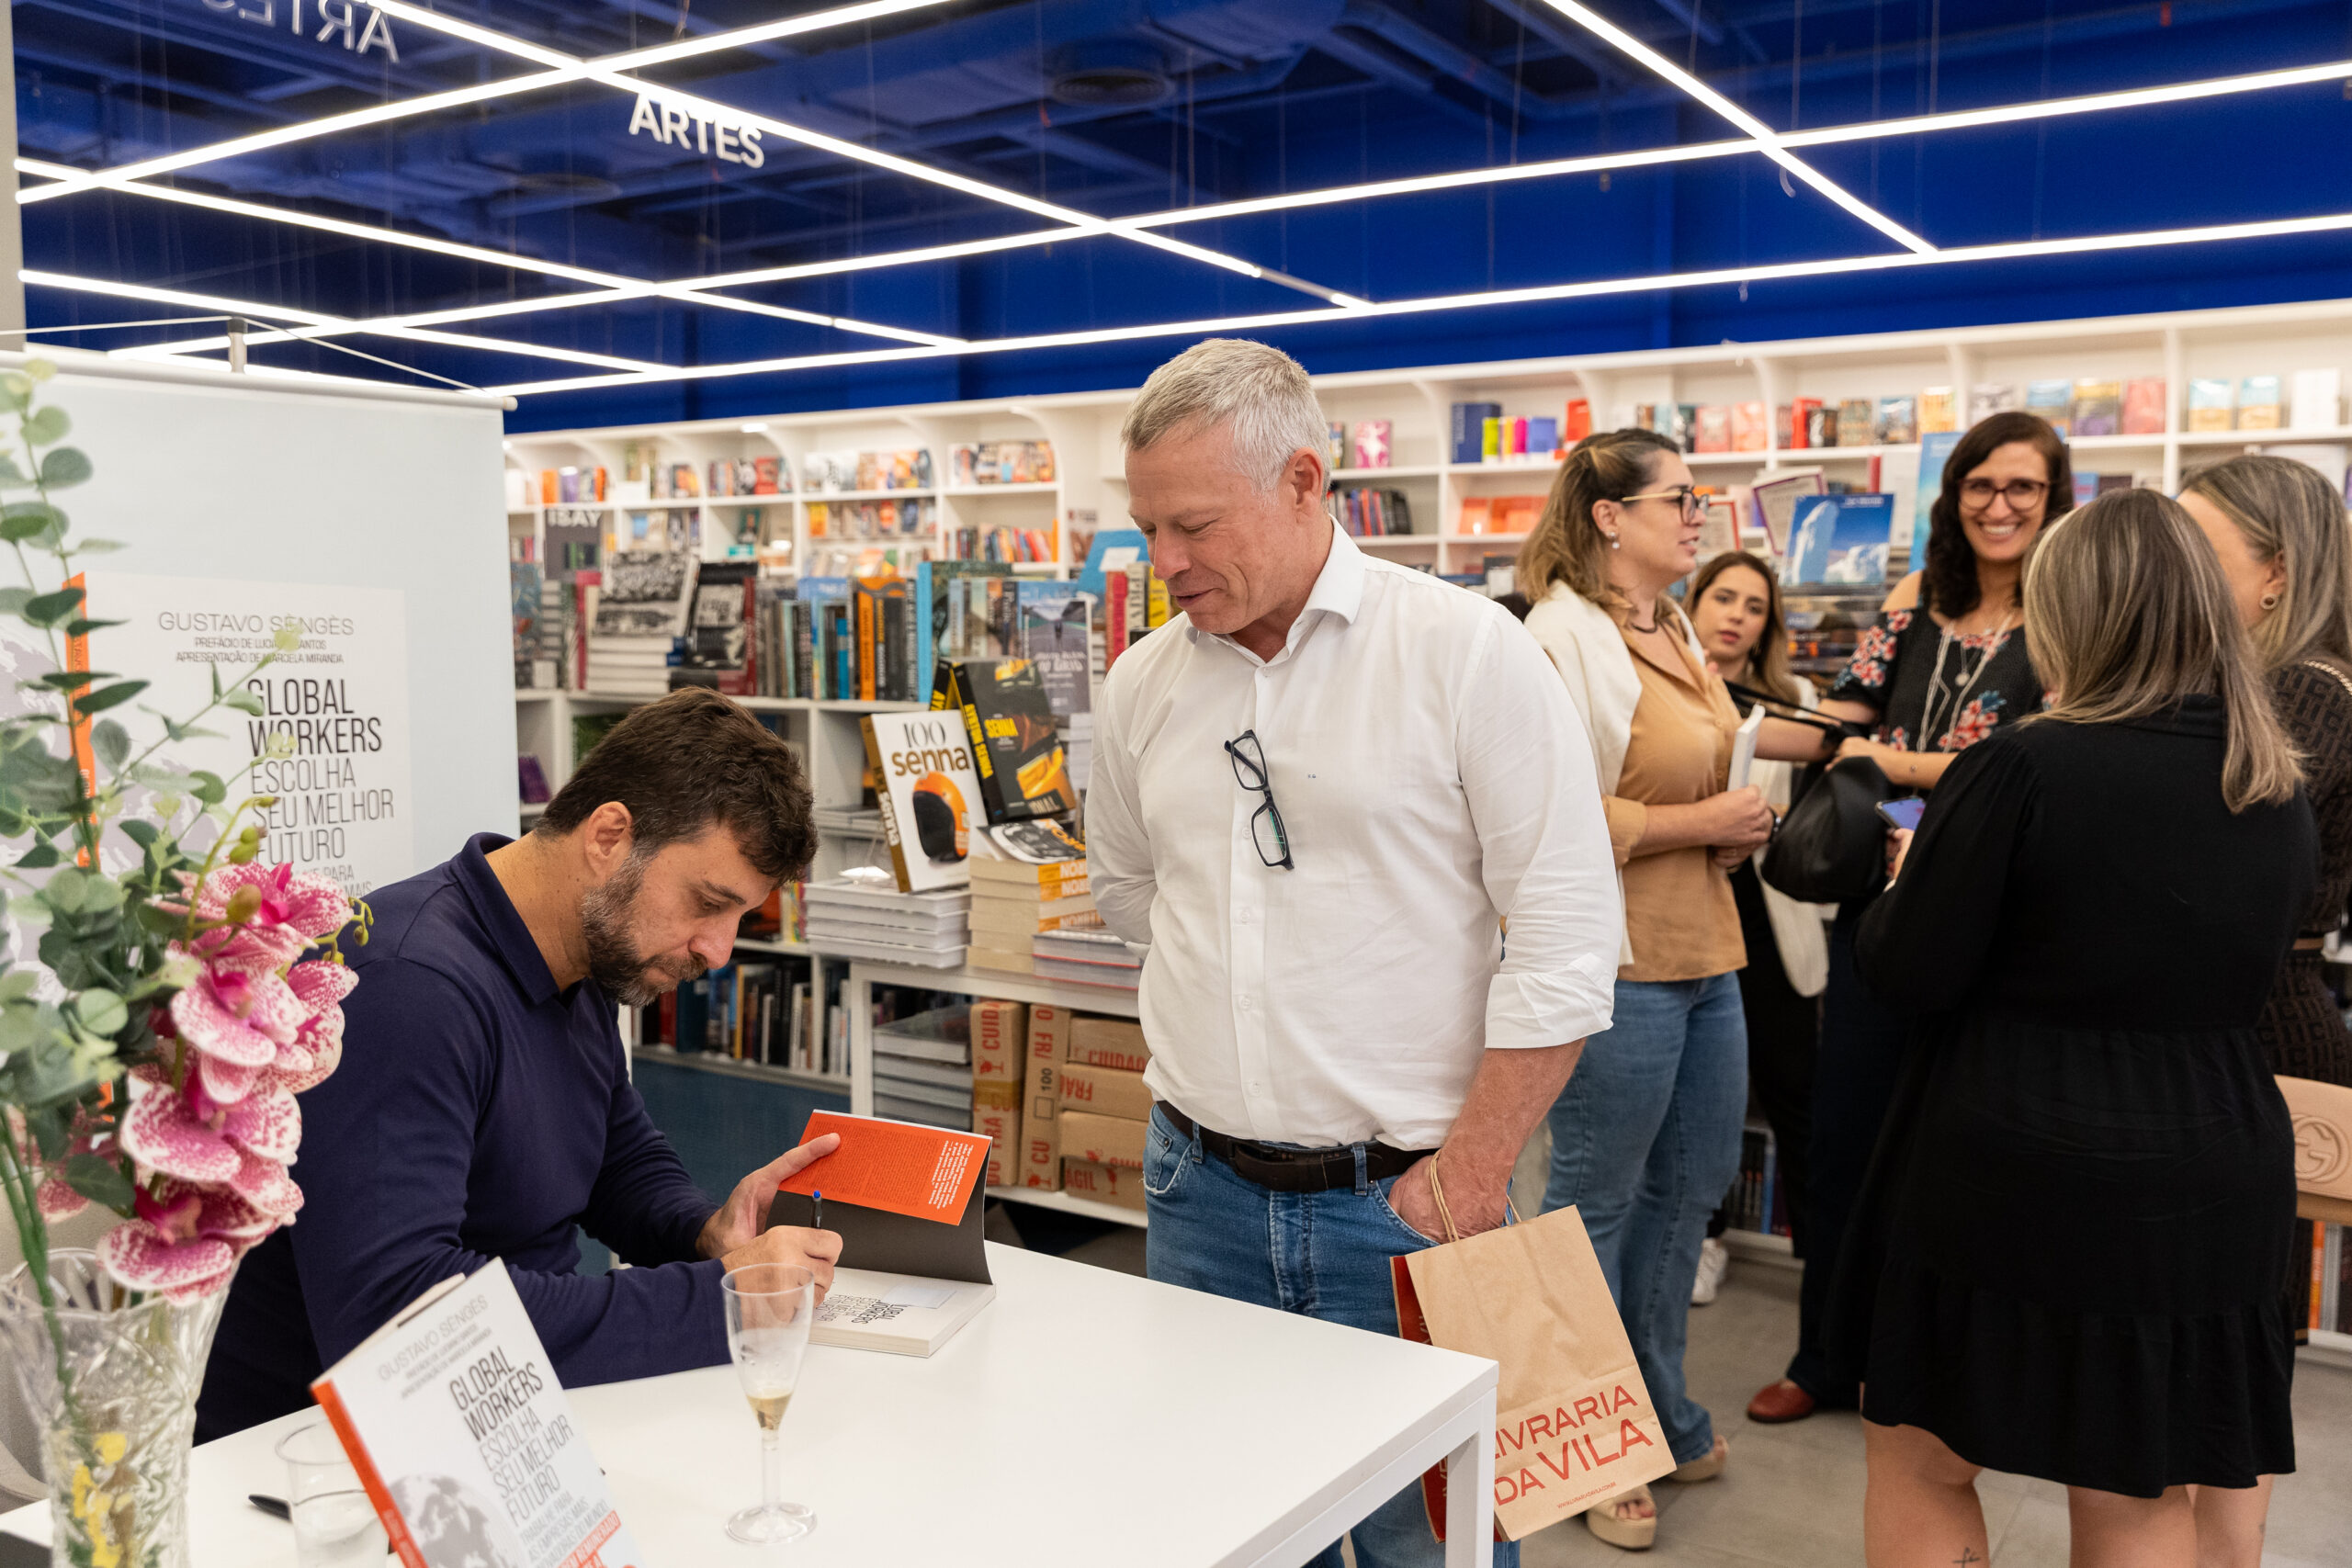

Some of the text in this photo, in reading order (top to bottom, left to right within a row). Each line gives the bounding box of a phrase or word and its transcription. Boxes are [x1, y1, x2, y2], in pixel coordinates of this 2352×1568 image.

[628, 93, 764, 168] ARTES
[158, 611, 264, 633] GUSTAVO
[241, 637, 252, 649] DE
[306, 653, 345, 664] MIRANDA
[247, 678, 355, 716] GLOBAL
[248, 716, 382, 758] WORKERS
[903, 720, 946, 748] 100
[251, 757, 356, 794] ESCOLHA
[891, 746, 971, 776] senna
[253, 788, 394, 829] SEU MELHOR
[449, 1346, 515, 1411] GLOBAL
[463, 1361, 544, 1441] WORKERS
[479, 1405, 542, 1472] ESCOLHA
[492, 1414, 574, 1499] SEU MELHOR
[1494, 1468, 1545, 1506] DA
[1536, 1418, 1654, 1481] VILA
[505, 1463, 561, 1528] FUTURO
